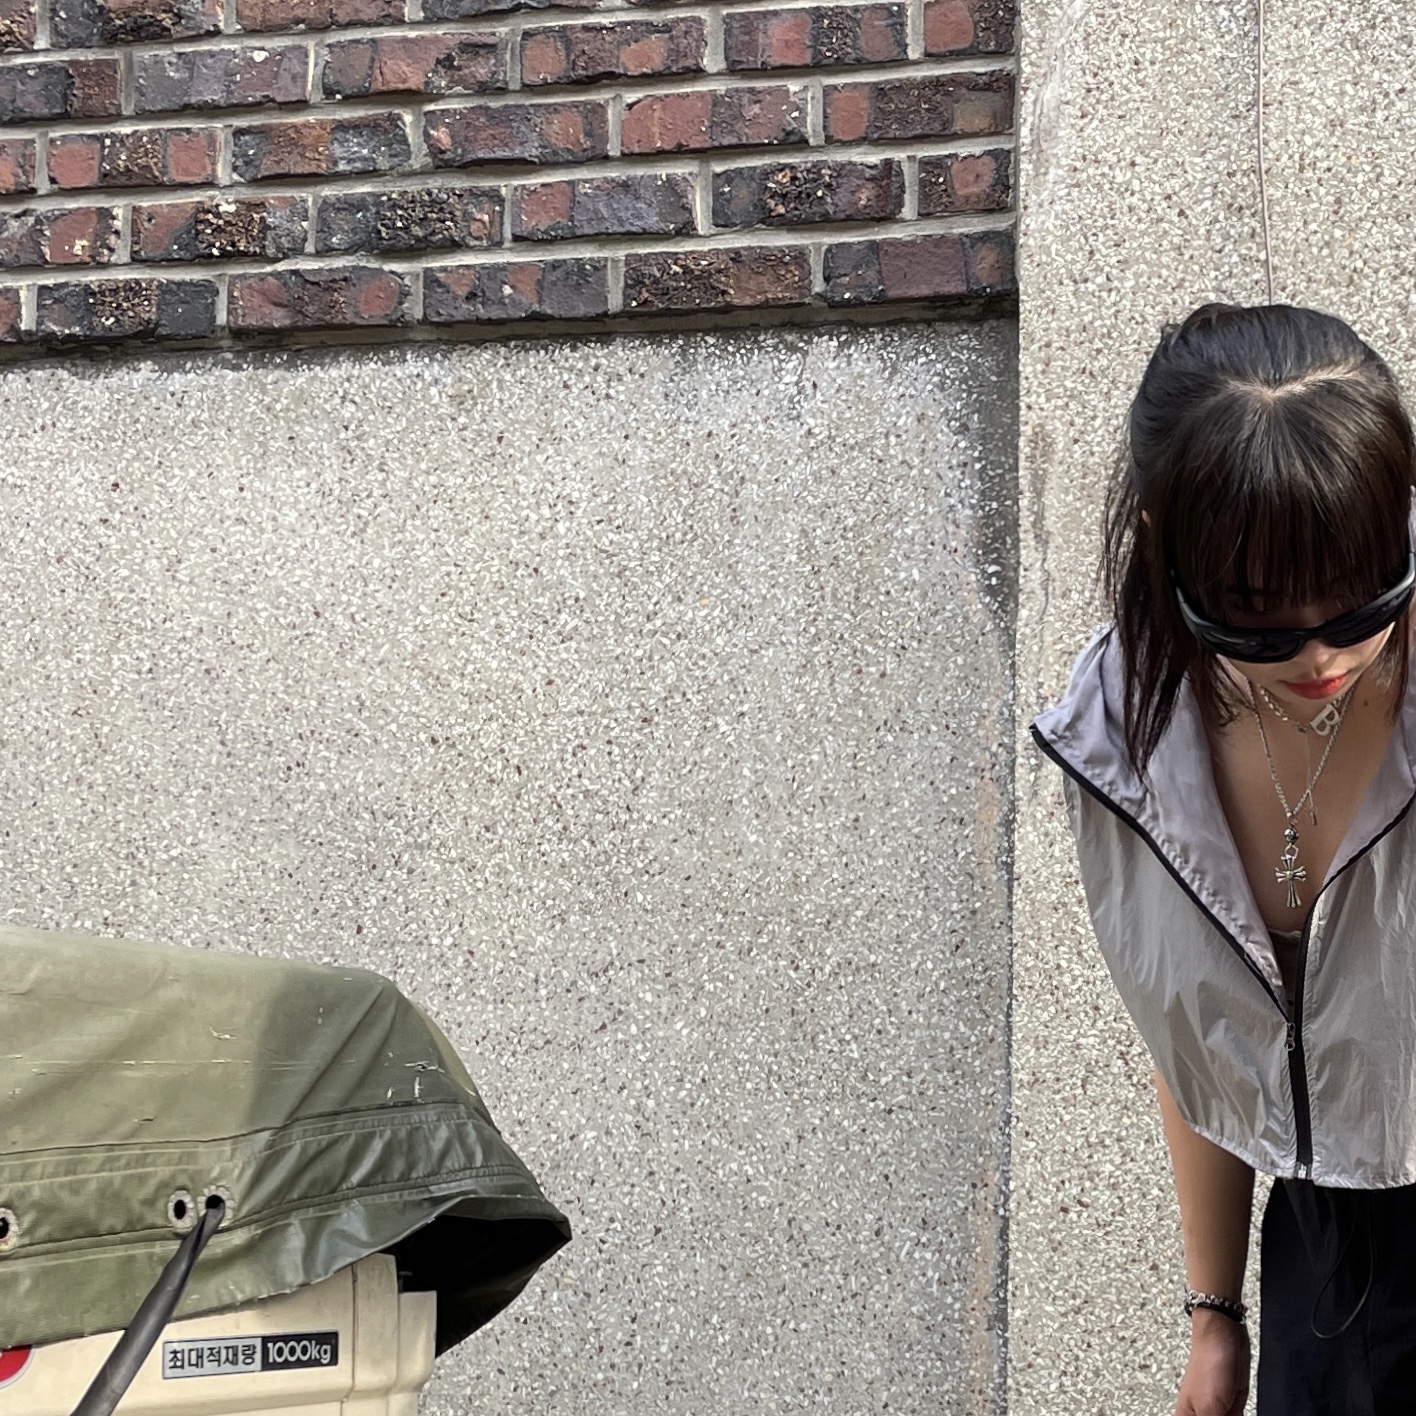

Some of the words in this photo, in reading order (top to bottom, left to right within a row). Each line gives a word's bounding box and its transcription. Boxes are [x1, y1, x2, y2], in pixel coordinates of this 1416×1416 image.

[1310, 704, 1339, 737] B
[168, 1344, 258, 1370] 최대적재량
[267, 1340, 332, 1364] 1000kg
